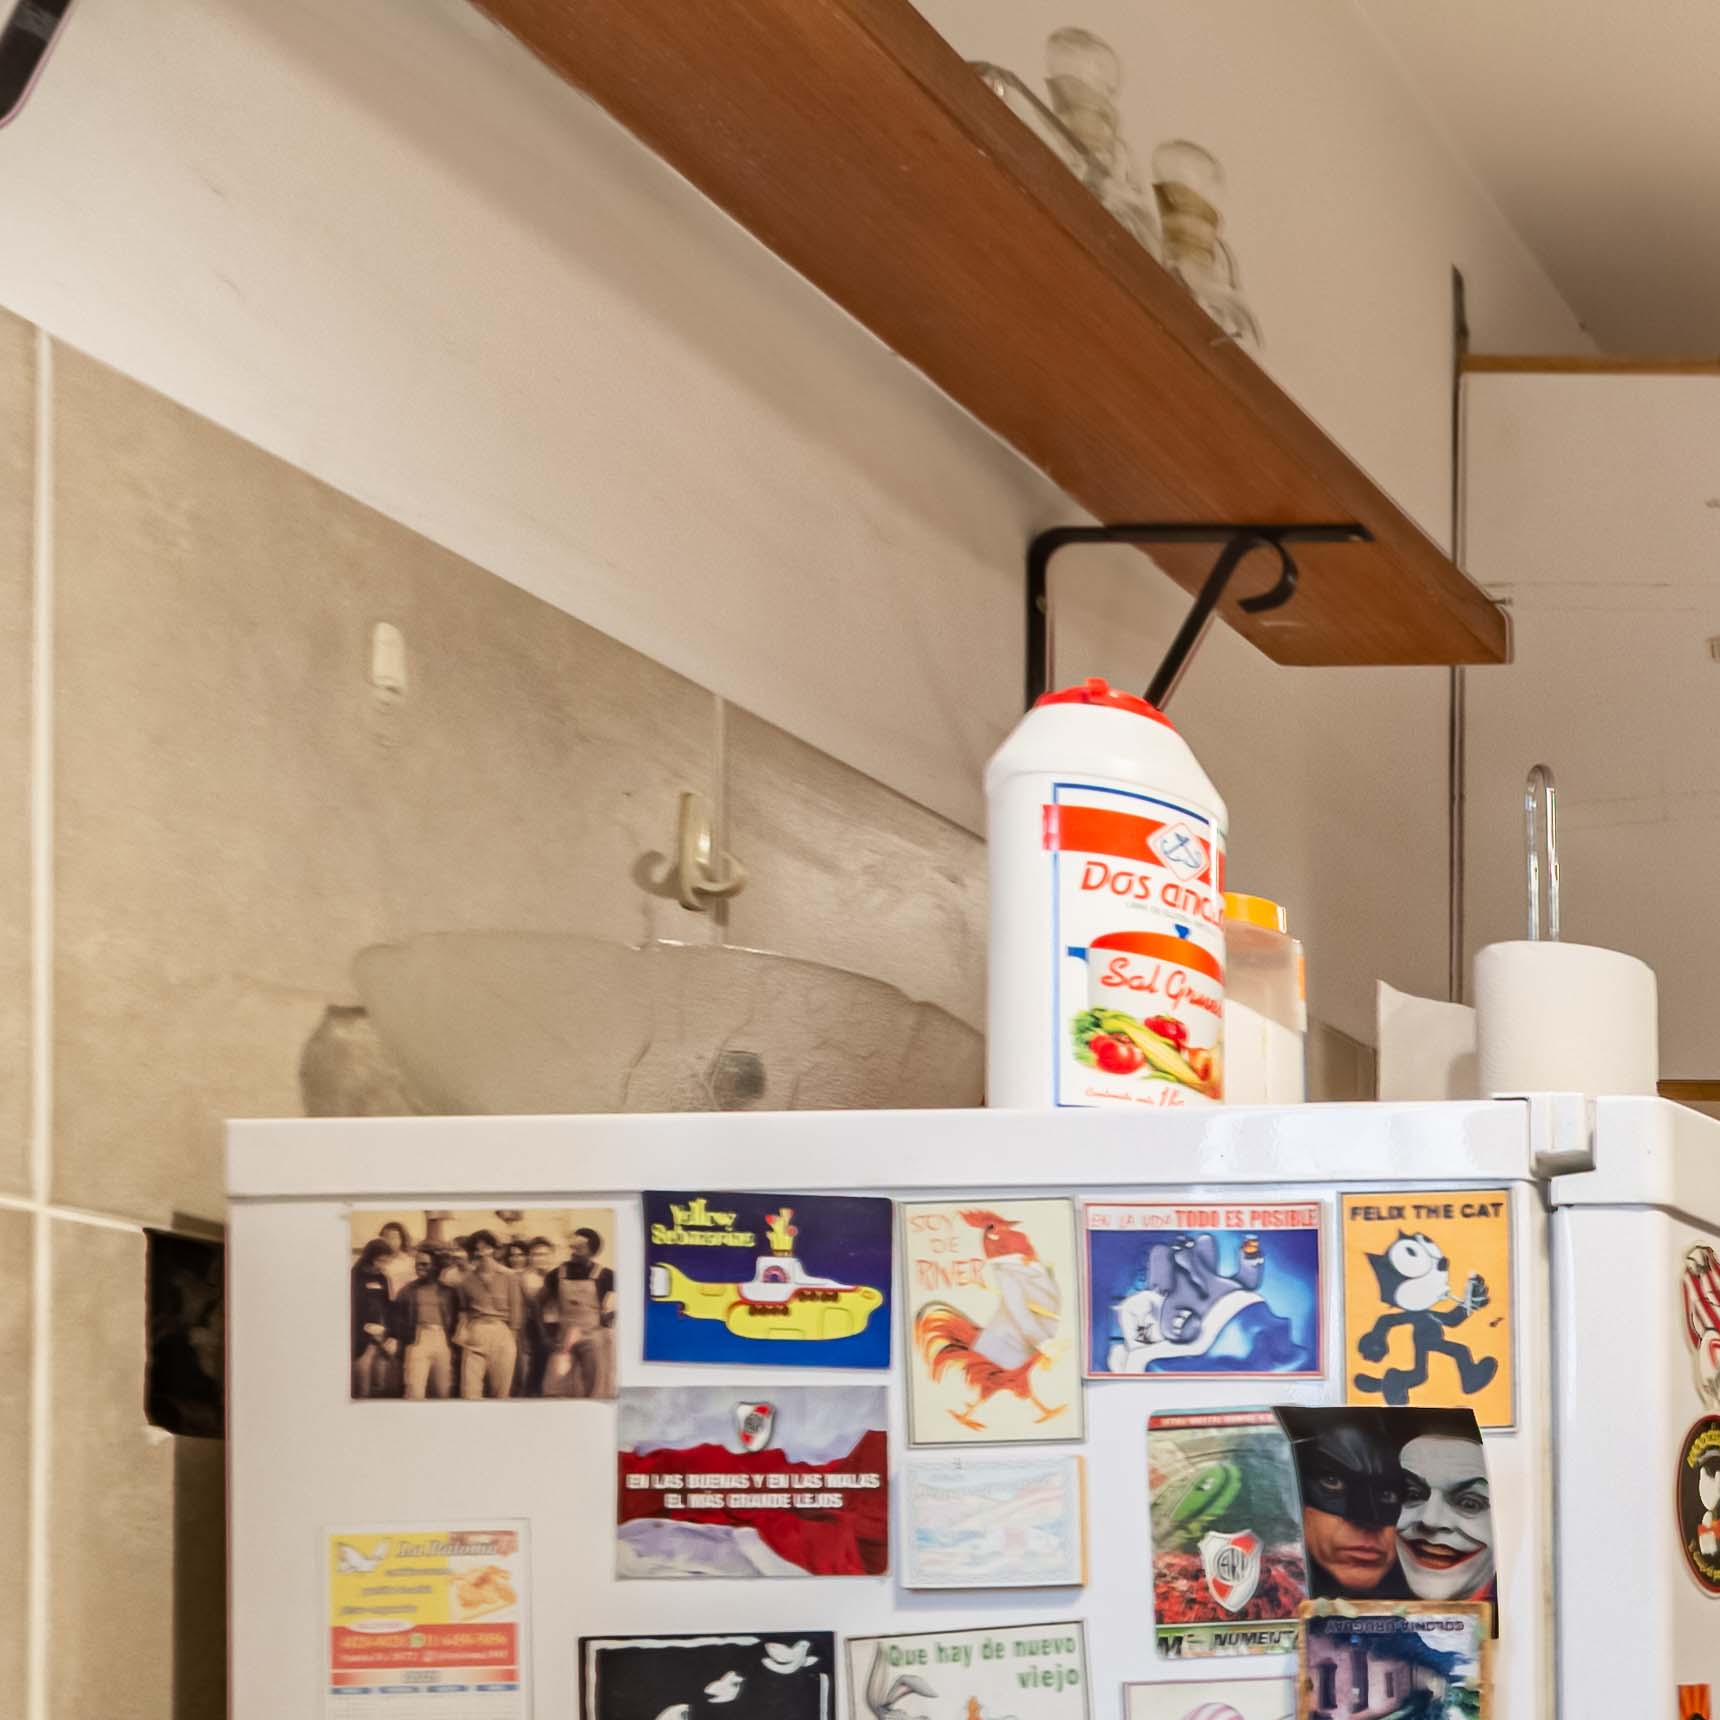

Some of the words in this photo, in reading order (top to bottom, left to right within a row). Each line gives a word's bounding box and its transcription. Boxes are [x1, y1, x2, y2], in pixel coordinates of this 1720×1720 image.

[1081, 861, 1151, 900] Dos
[1101, 957, 1160, 993] Sal
[1175, 1210, 1219, 1228] TODO
[1225, 1209, 1245, 1227] ES
[1250, 1208, 1319, 1227] POSIBLE
[1351, 1205, 1406, 1221] FELIX
[1413, 1203, 1455, 1219] THE
[1461, 1202, 1504, 1218] CAT
[625, 1473, 650, 1489] EN
[652, 1473, 684, 1489] LAS
[686, 1473, 750, 1489] BUENAS
[751, 1473, 764, 1489] Y
[766, 1473, 789, 1489] EN
[791, 1473, 823, 1489] LAS
[824, 1473, 880, 1489] MALAS
[664, 1493, 686, 1509] EL
[727, 1493, 791, 1509] GRANDE
[887, 1643, 928, 1667] Que
[935, 1641, 974, 1668] hay
[980, 1636, 1005, 1661] de
[1013, 1637, 1076, 1657] nuevo
[1017, 1664, 1080, 1692] viejo
